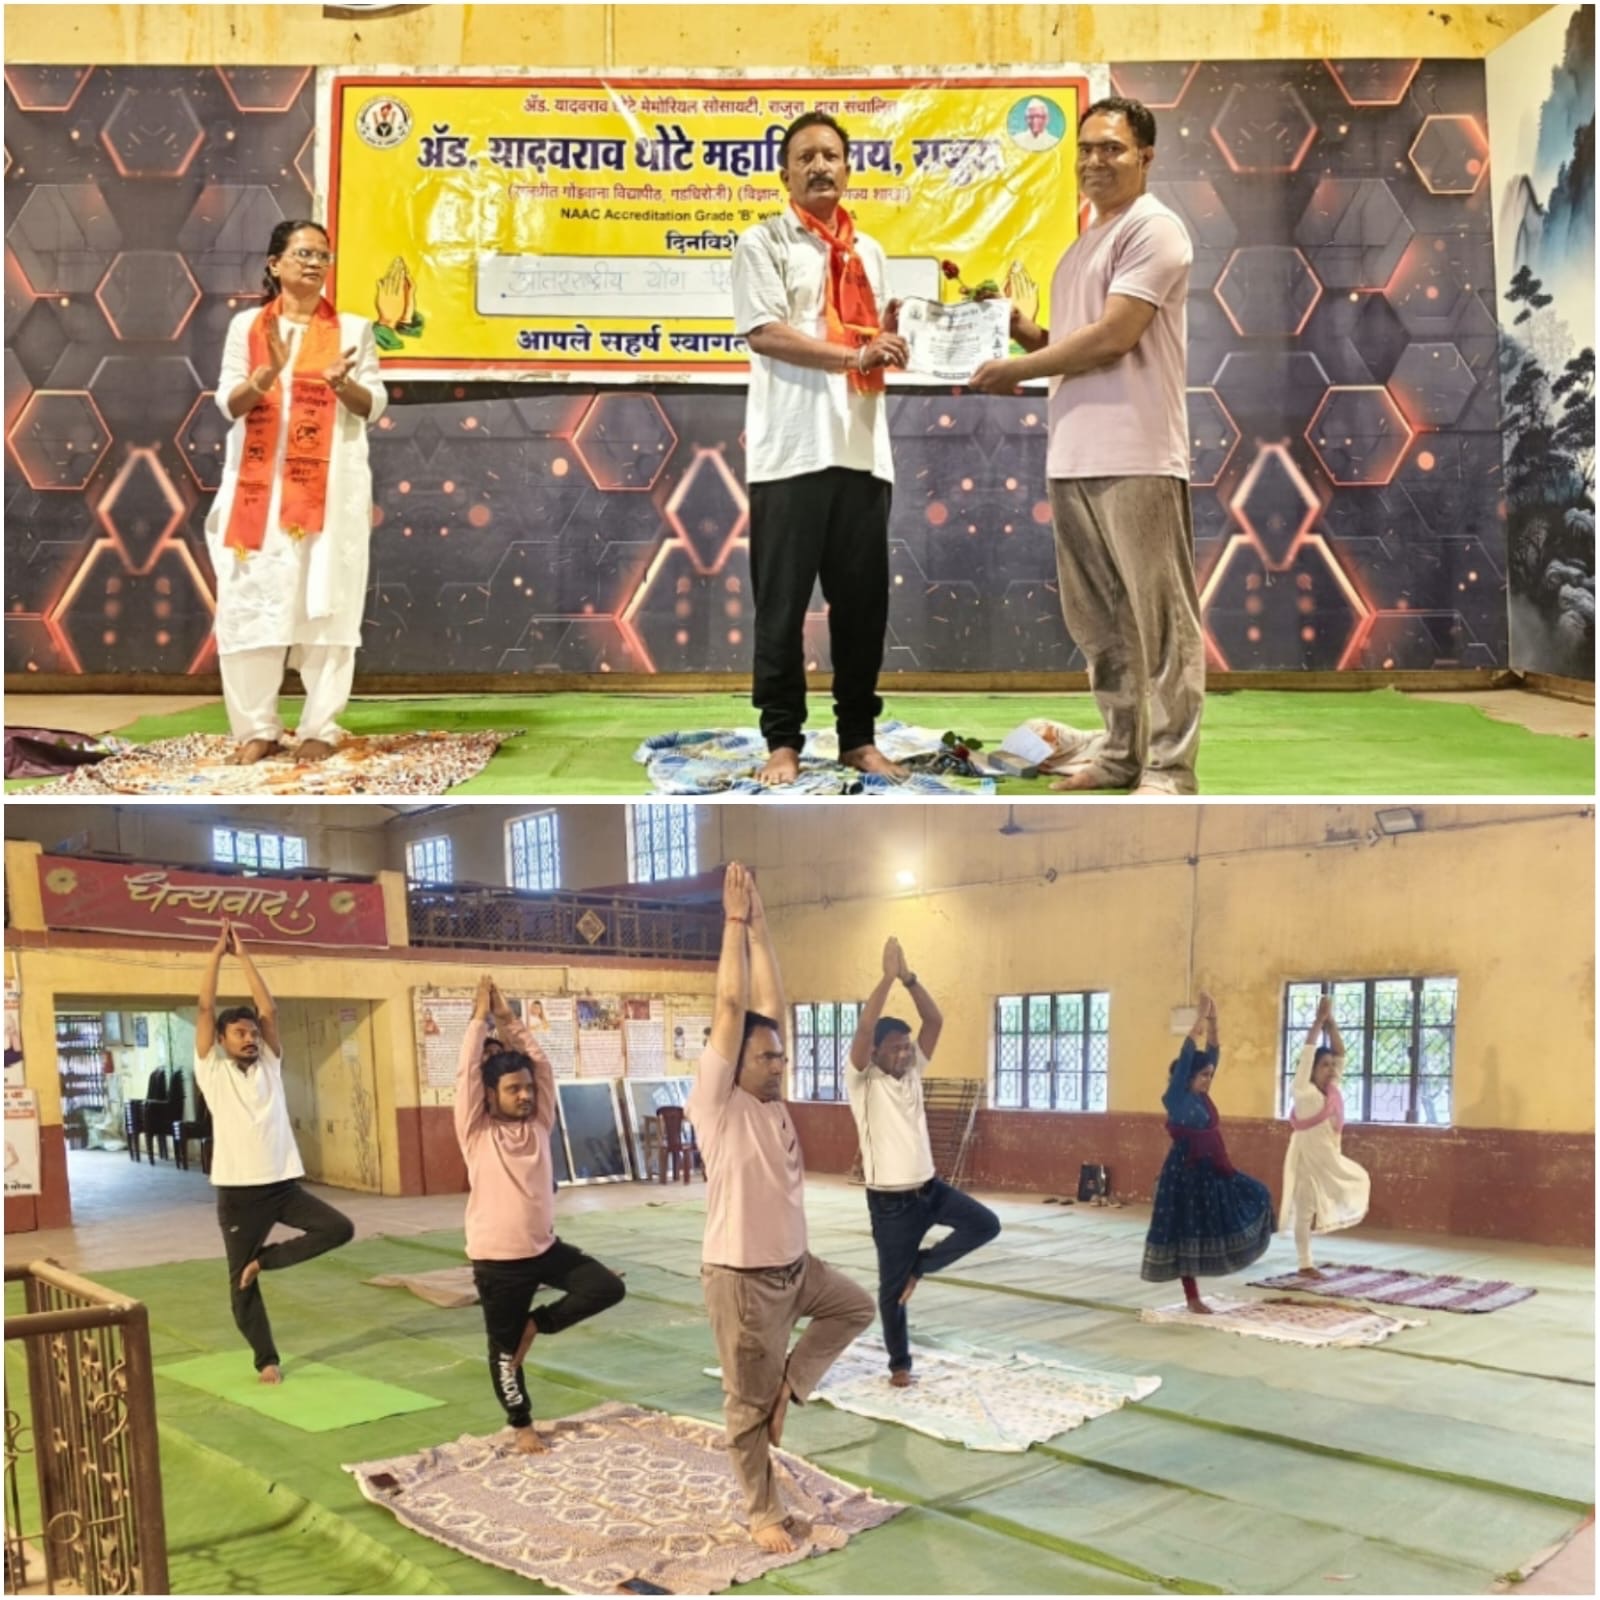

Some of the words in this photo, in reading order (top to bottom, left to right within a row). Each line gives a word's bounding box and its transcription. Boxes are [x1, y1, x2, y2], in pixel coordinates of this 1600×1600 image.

[554, 99, 608, 113] यादवराव
[640, 95, 698, 113] मेमोरियल
[488, 137, 626, 173] यादवराव
[635, 125, 693, 170] धोटे
[561, 208, 600, 220] NAAC
[604, 208, 691, 222] Accreditation
[695, 209, 734, 222] Grade
[517, 324, 592, 350] आपले
[601, 324, 662, 356] सहर्ष
